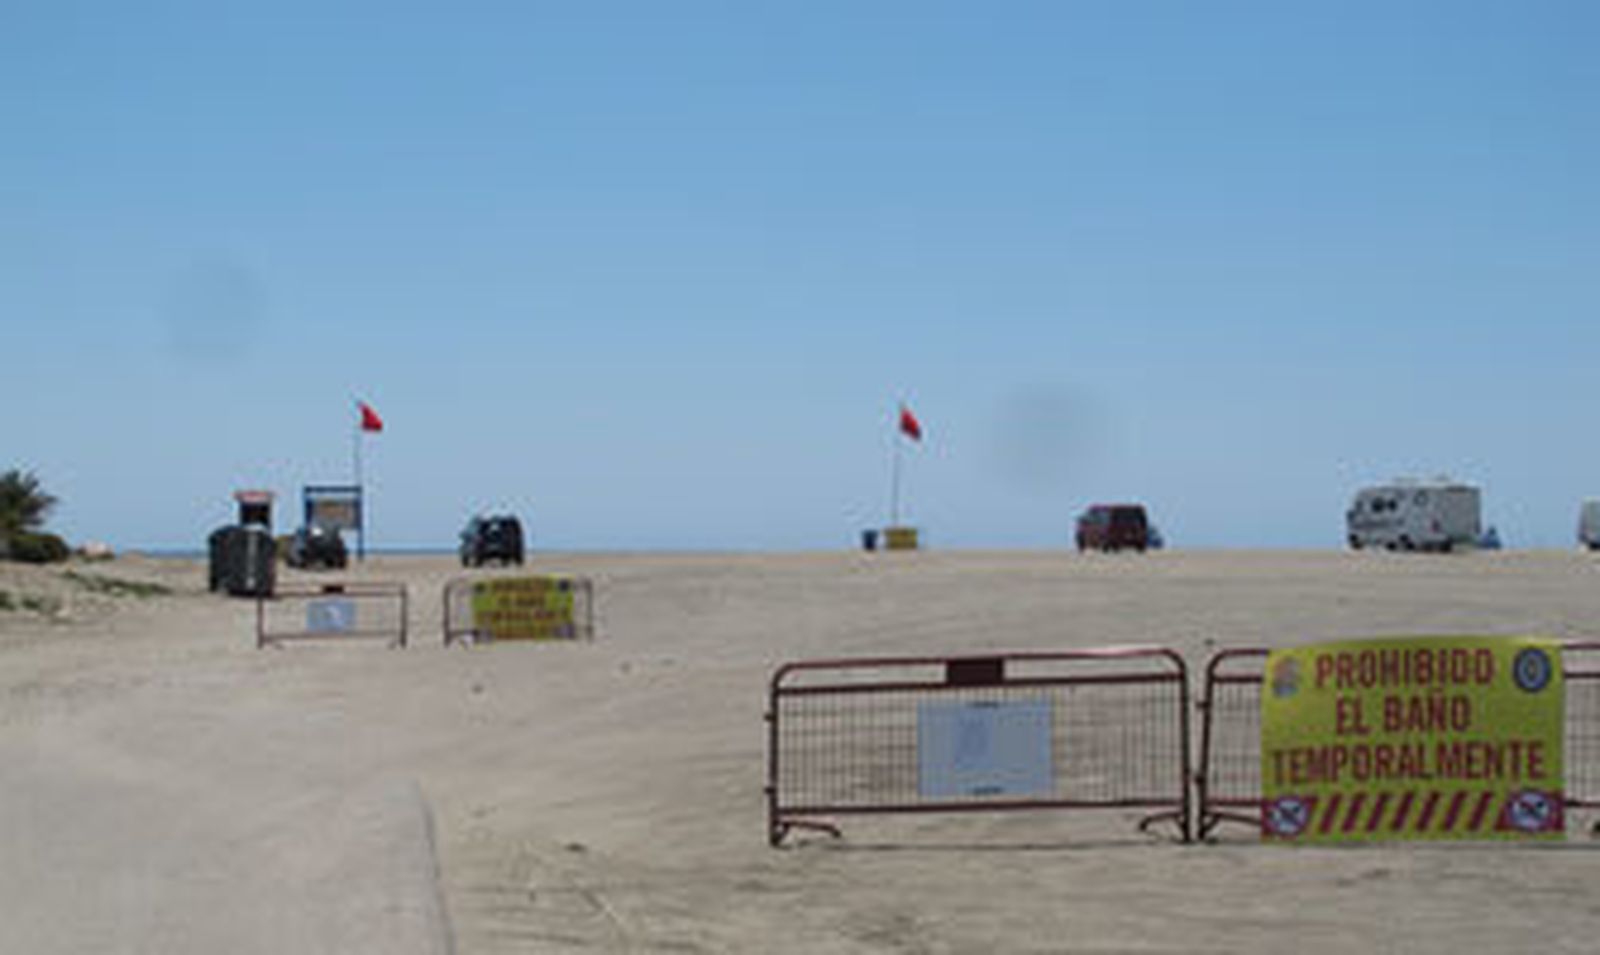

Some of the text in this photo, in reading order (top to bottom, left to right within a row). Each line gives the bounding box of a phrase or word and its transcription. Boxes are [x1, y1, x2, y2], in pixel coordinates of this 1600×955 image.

[1314, 648, 1495, 689] PROHIBIDO
[1335, 688, 1472, 736] EL BAÑO
[1270, 740, 1547, 786] TEMPORALMENTE
